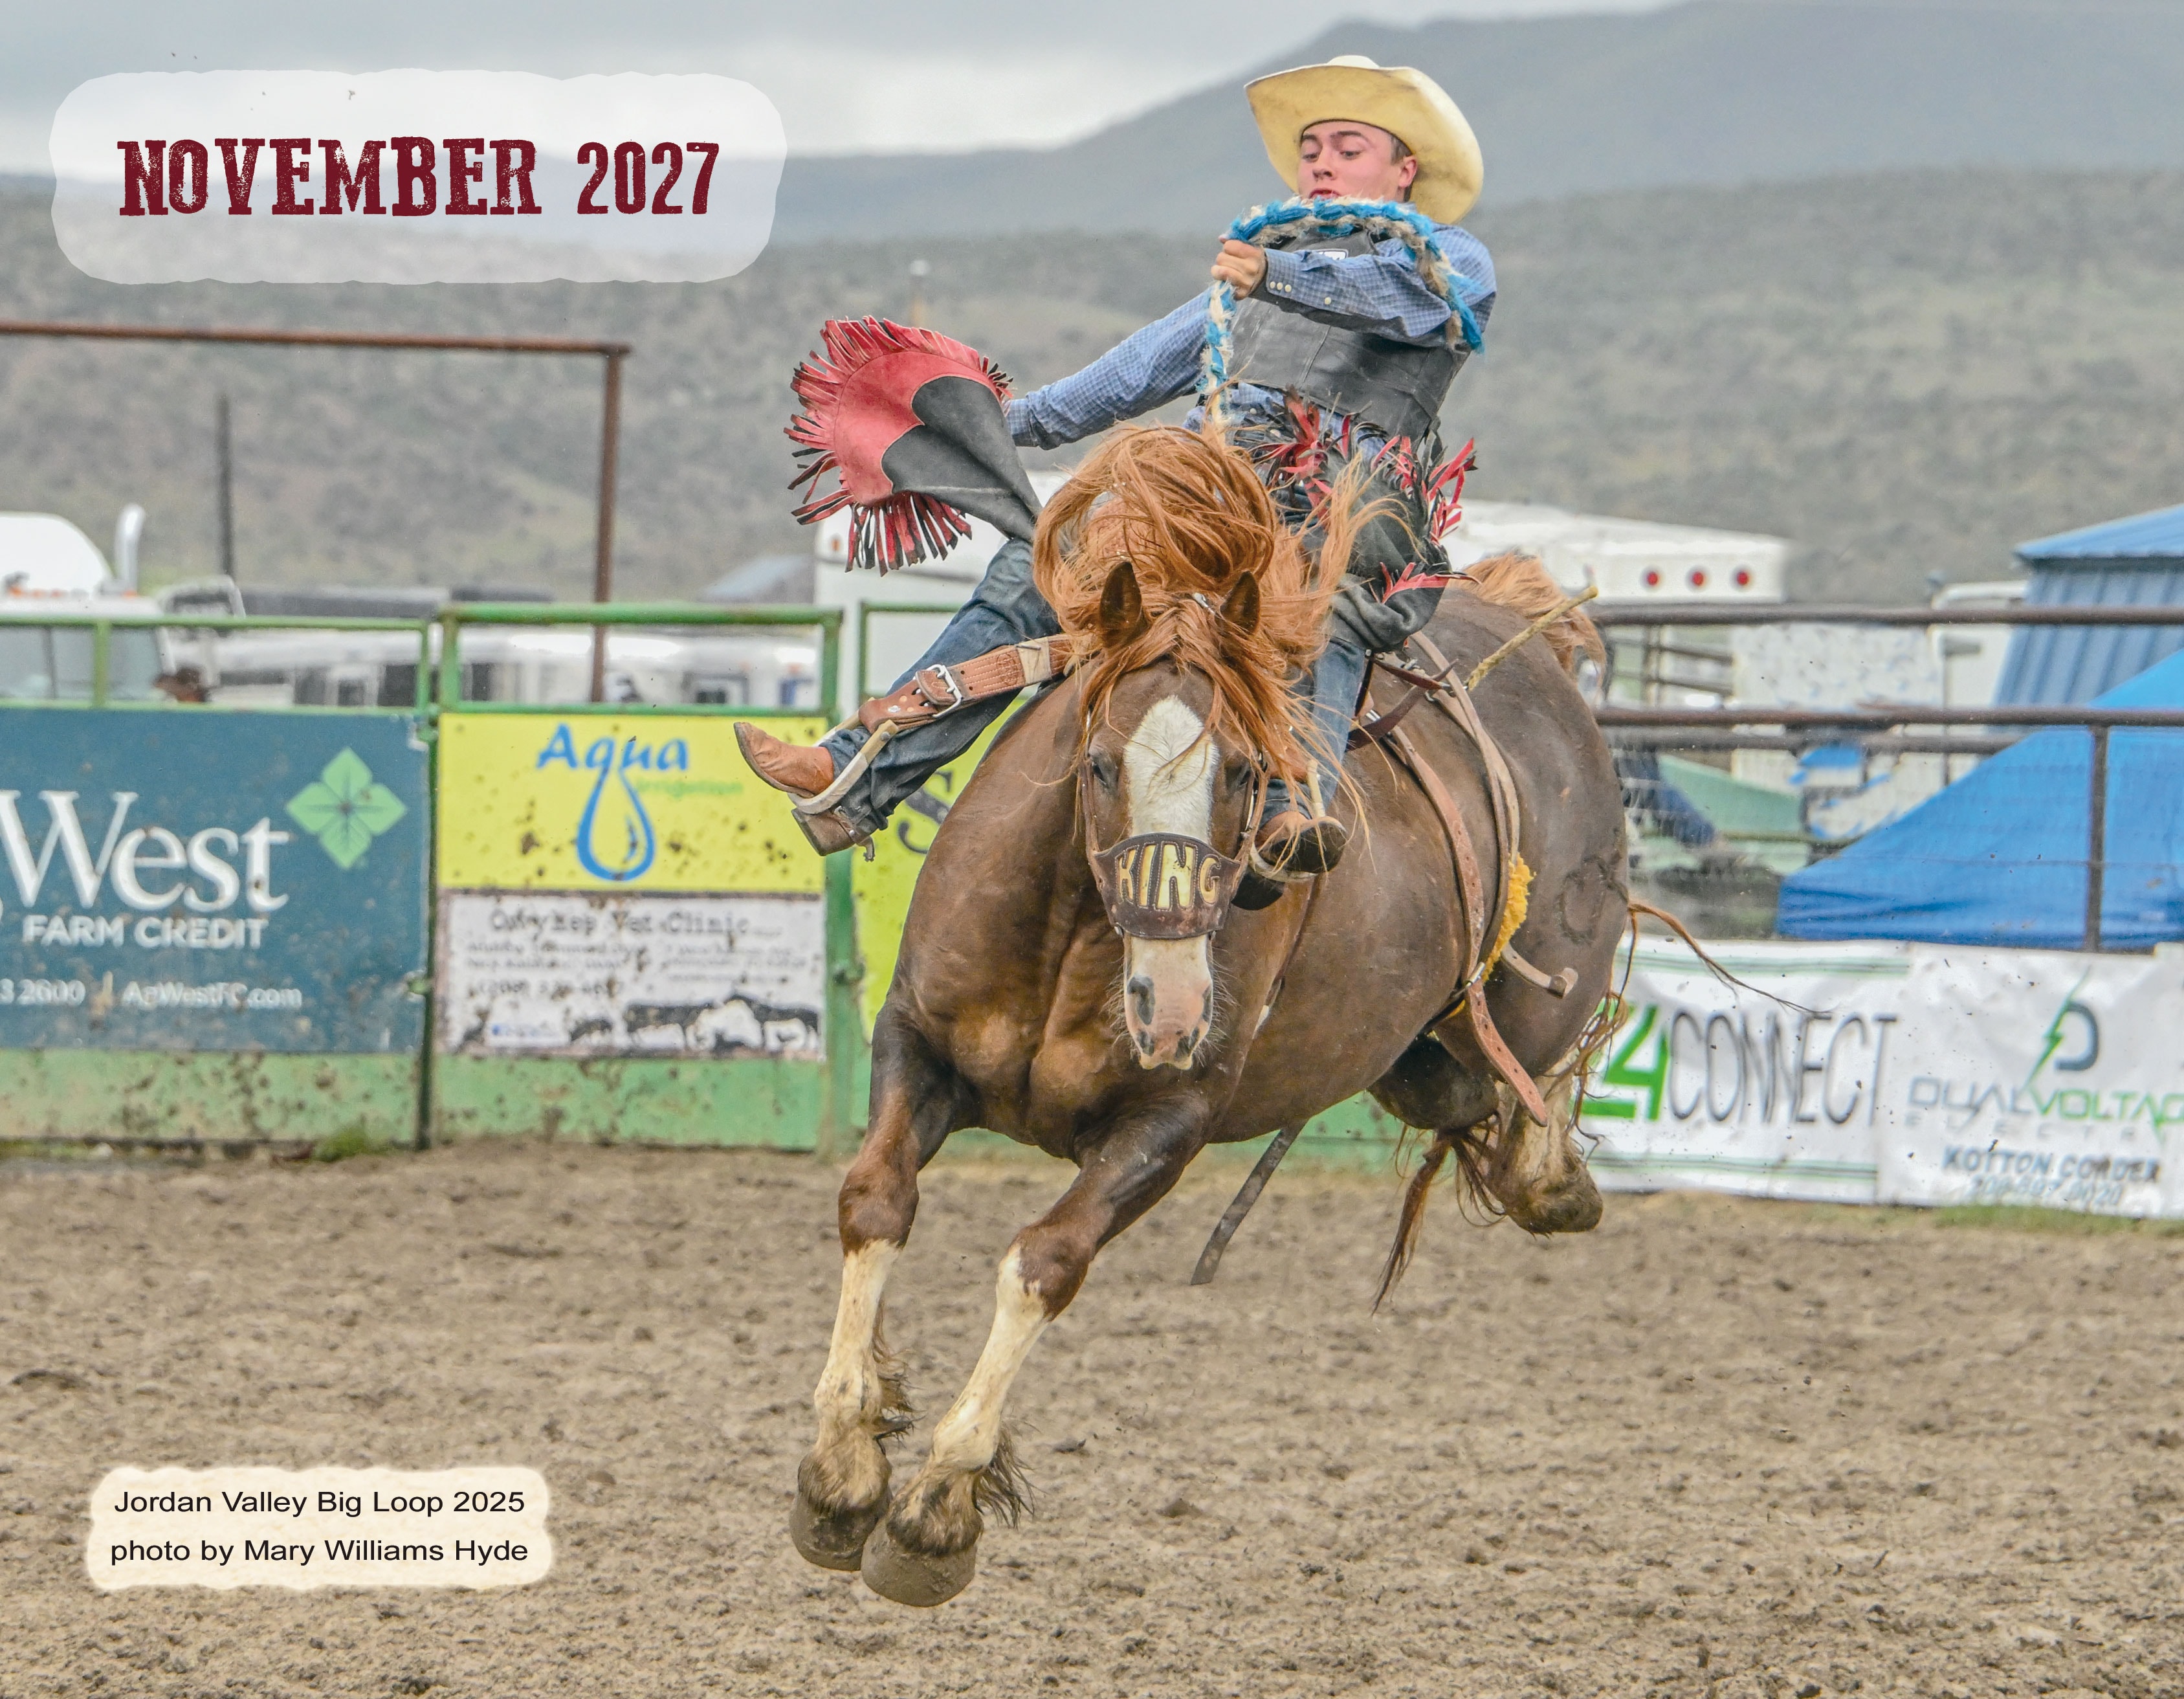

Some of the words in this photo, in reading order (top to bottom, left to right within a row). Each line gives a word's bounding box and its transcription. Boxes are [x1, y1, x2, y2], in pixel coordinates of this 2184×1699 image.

[536, 722, 689, 772] Aqua
[1114, 841, 1221, 911] KING
[22, 915, 126, 946] FARM
[133, 916, 269, 949] CREDIT
[1943, 1144, 2054, 1175] KOTTON
